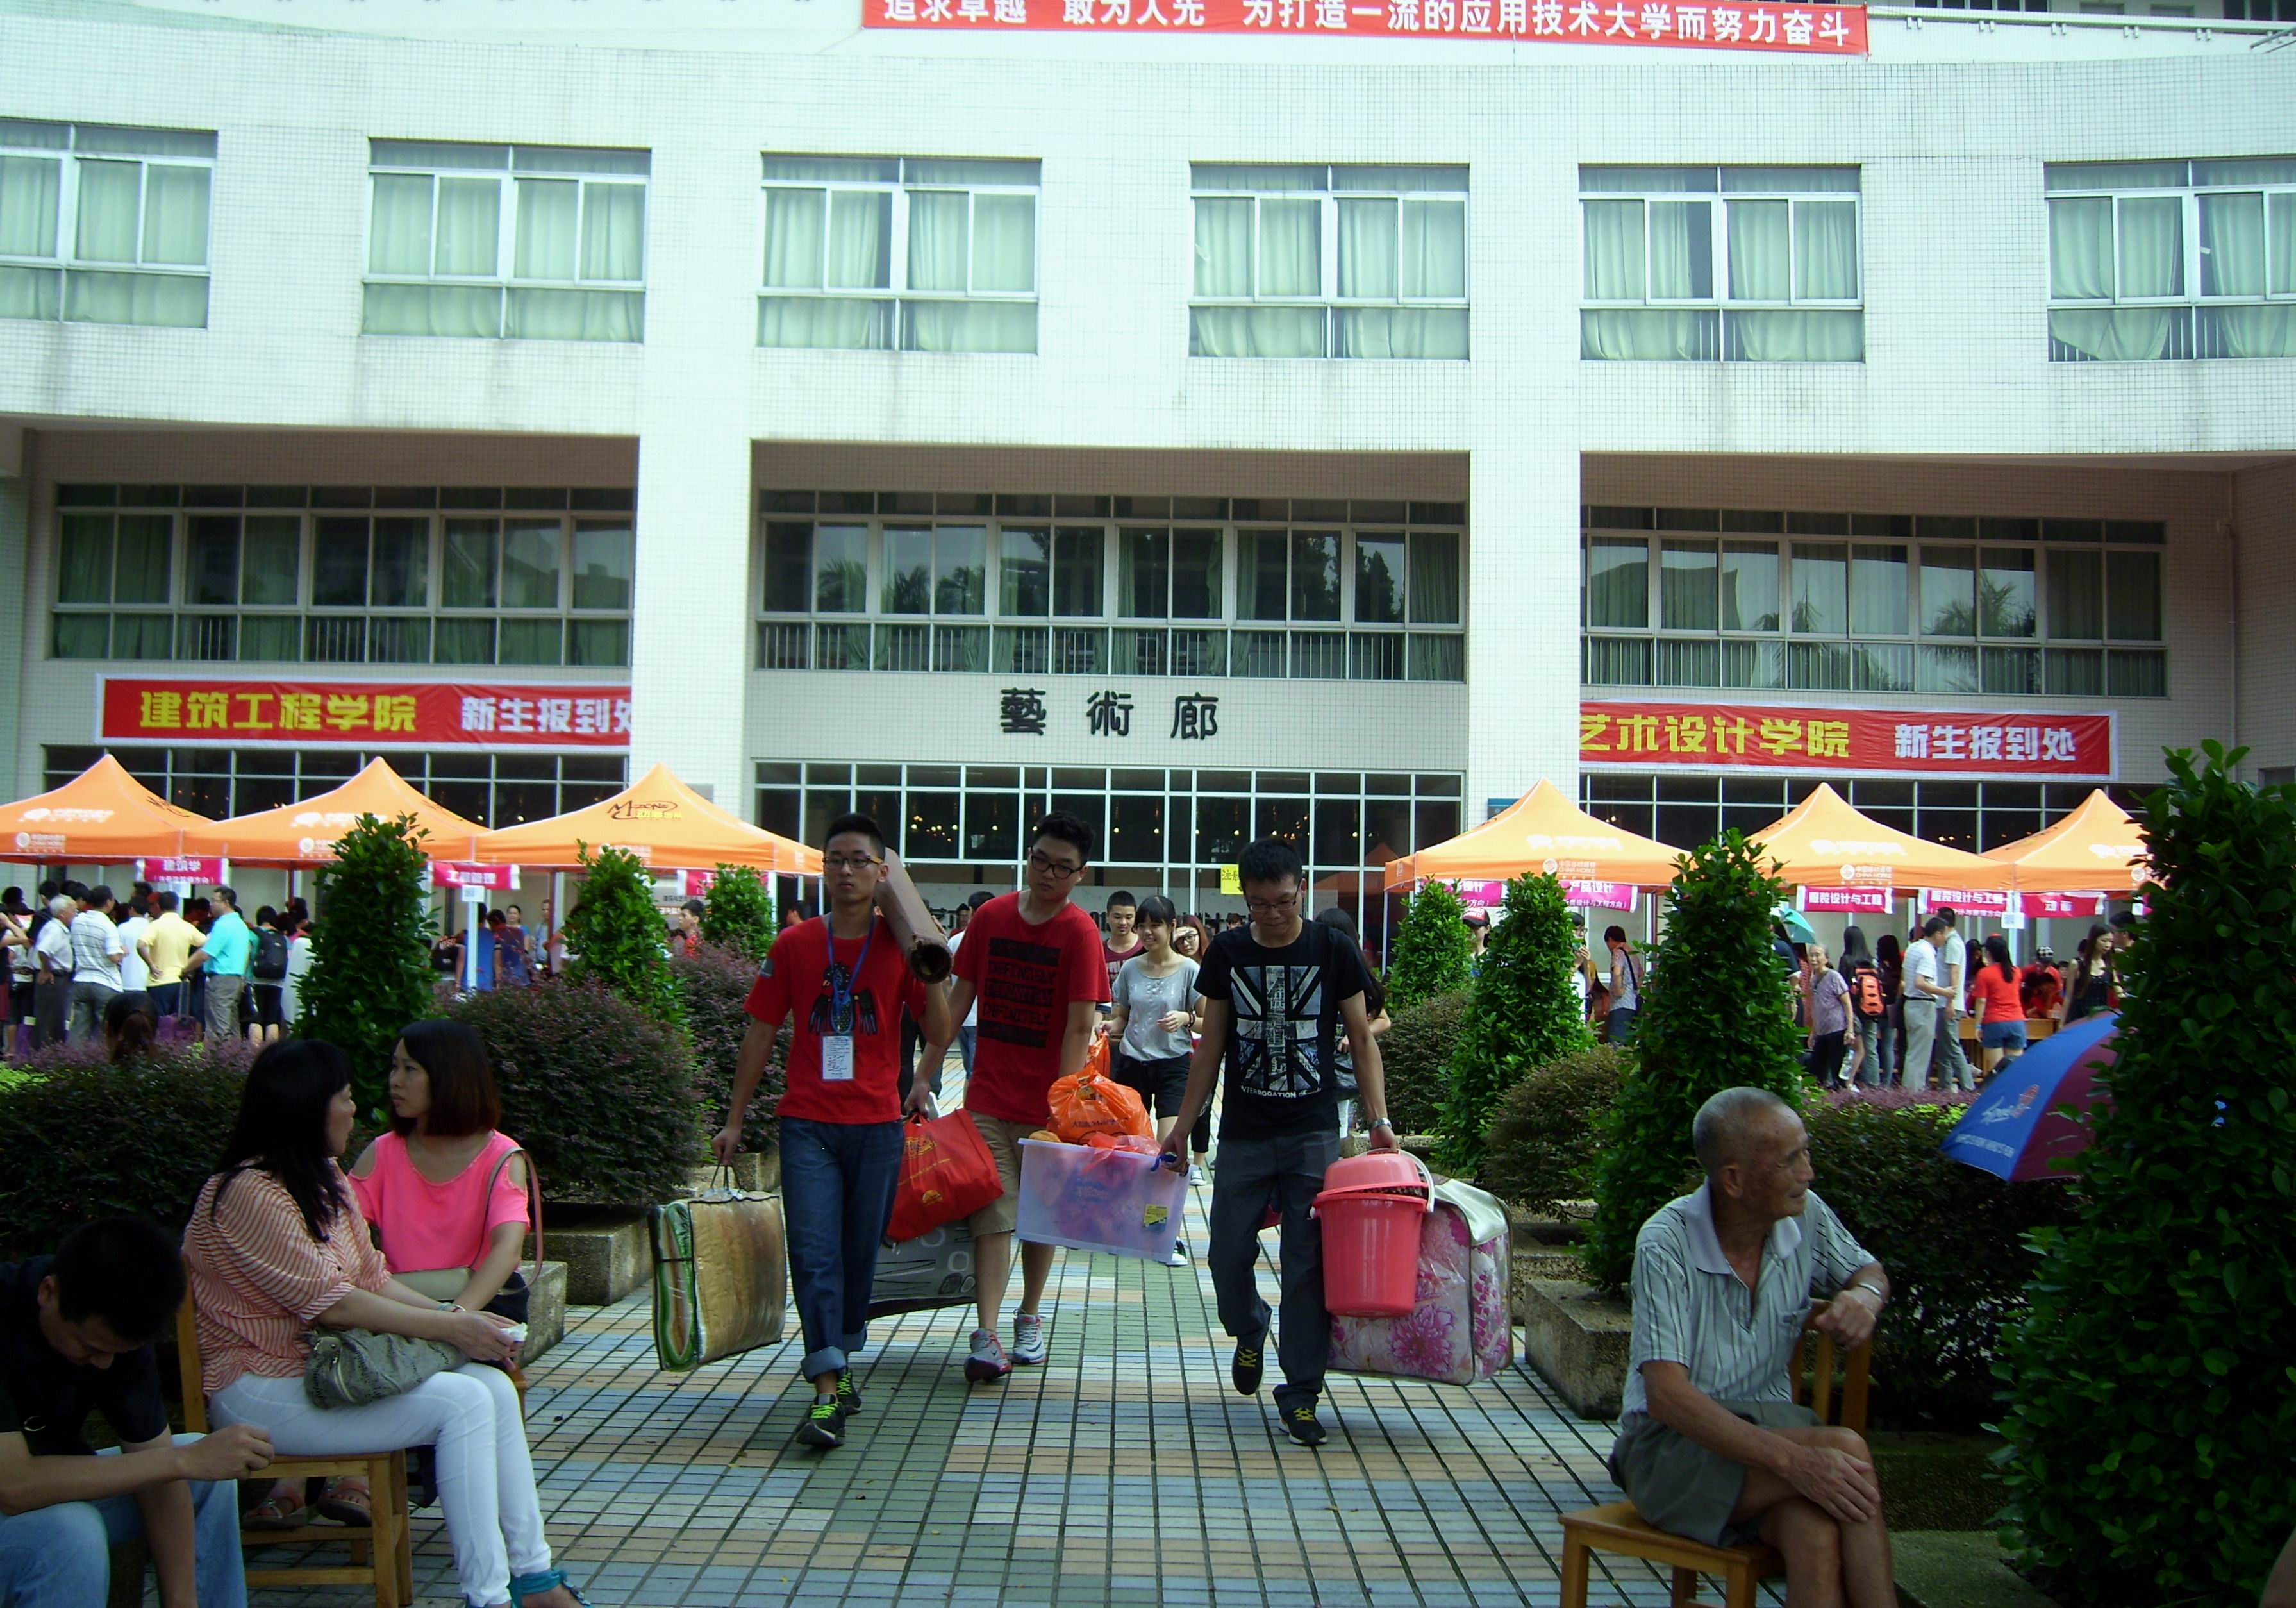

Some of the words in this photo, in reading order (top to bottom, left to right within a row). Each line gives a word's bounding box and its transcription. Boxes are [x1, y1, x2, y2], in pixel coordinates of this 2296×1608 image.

[1243, 0, 1850, 47] 为打造一流的应用技术大学而努力奋斗
[140, 690, 416, 732] 建筑工程学院
[1001, 688, 1219, 740] 藝術廊
[1580, 713, 1850, 758] 艺术设计学院
[1895, 724, 2076, 762] 新生报到处
[1570, 882, 1614, 893] 产品设计
[1809, 892, 1883, 906] 服装设计与工程
